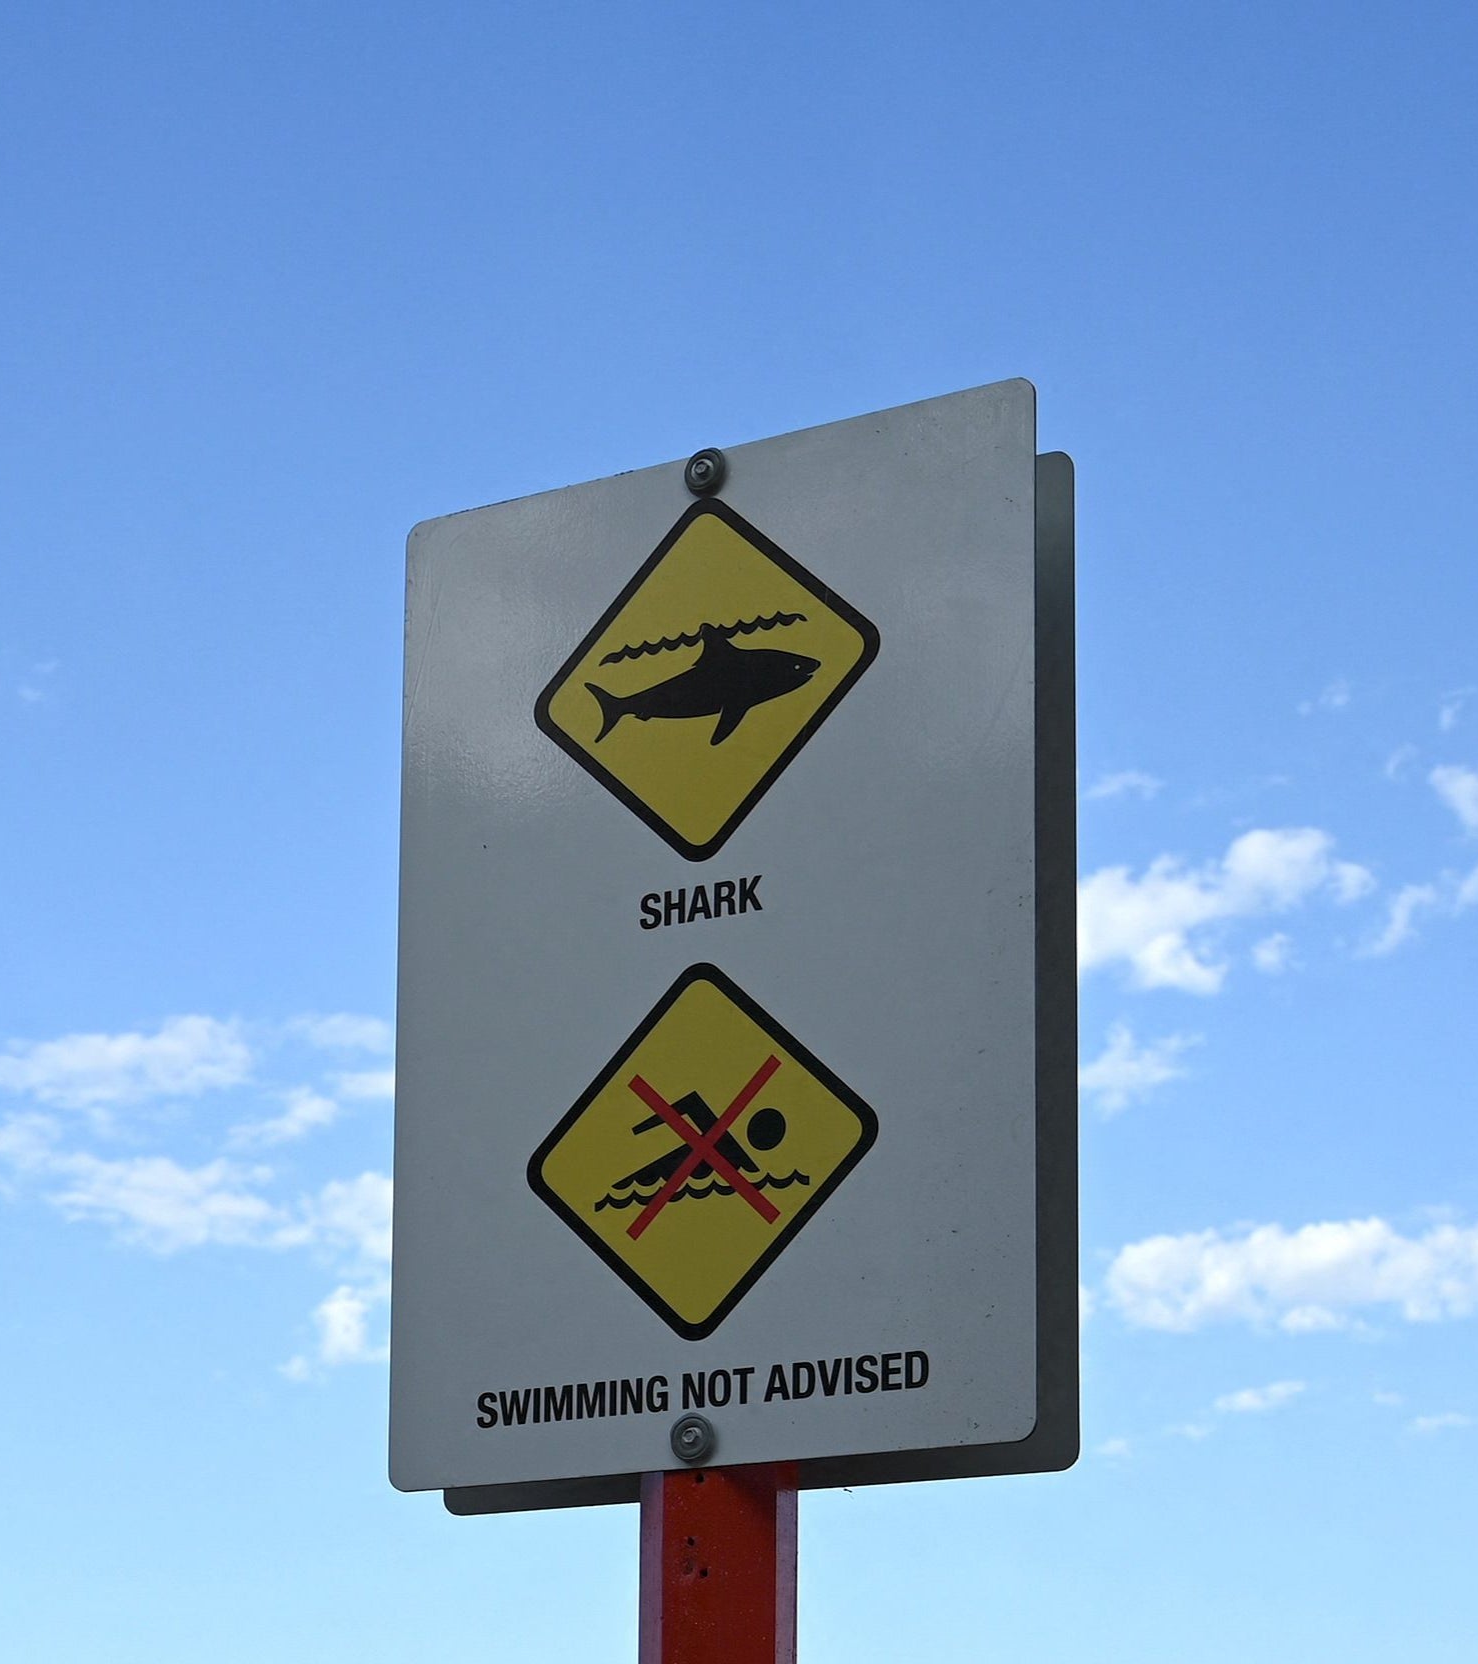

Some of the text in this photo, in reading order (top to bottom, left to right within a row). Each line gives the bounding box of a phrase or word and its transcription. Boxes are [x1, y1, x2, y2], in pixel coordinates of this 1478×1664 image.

[639, 875, 762, 930] SHARK
[476, 1350, 929, 1429] SWIMMING NOT ADVISED
